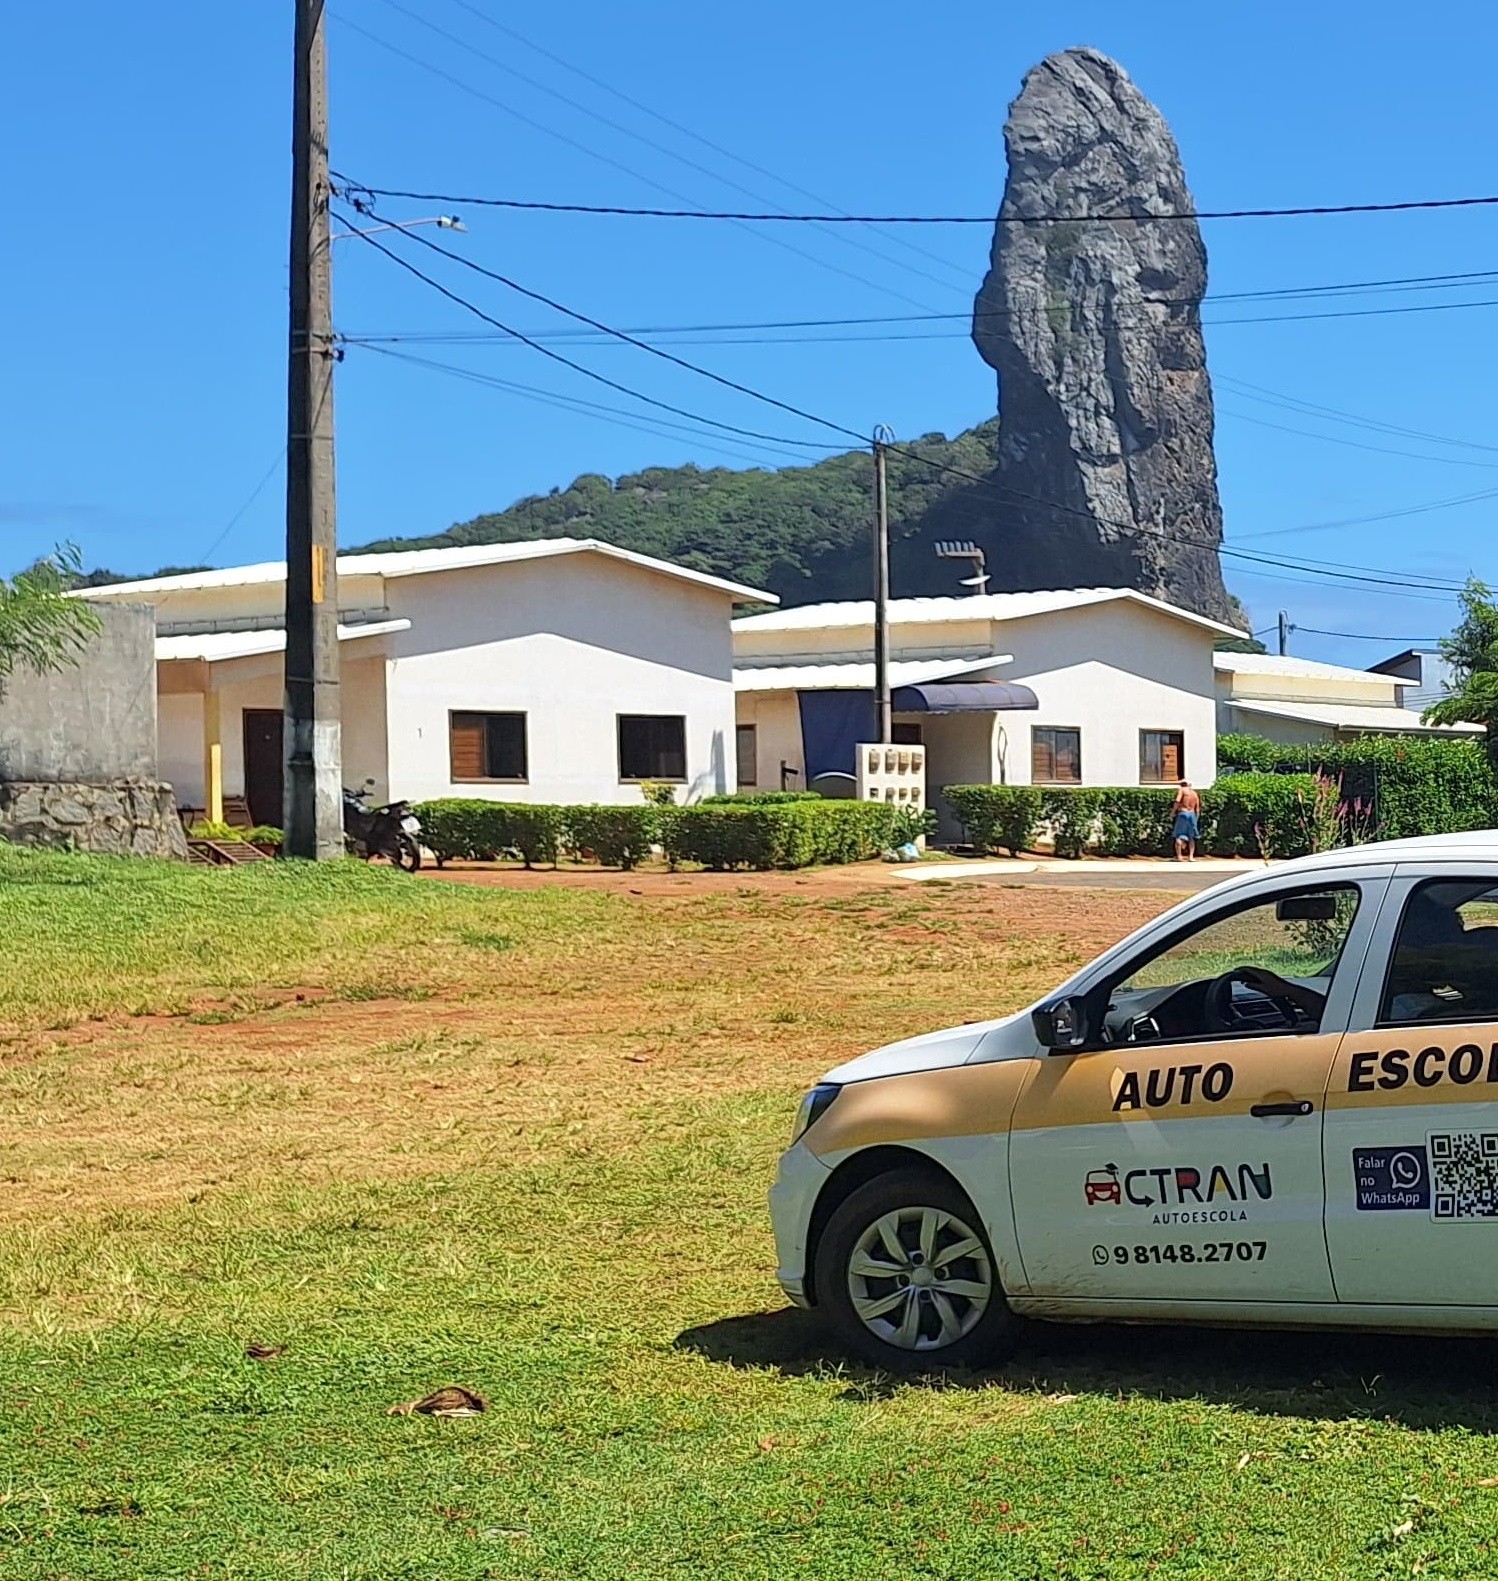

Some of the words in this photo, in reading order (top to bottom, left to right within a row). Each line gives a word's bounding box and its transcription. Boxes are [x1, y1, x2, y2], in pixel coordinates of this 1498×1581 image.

[1112, 1062, 1234, 1112] AUTO
[1358, 1156, 1385, 1169] Falar
[1124, 1162, 1273, 1208] CTRAN
[1360, 1177, 1375, 1187] no
[1361, 1191, 1420, 1206] WhatsApp
[1152, 1210, 1248, 1225] AUTOESCOLA
[1113, 1245, 1129, 1265] 9
[1133, 1241, 1268, 1265] 8148.2707
